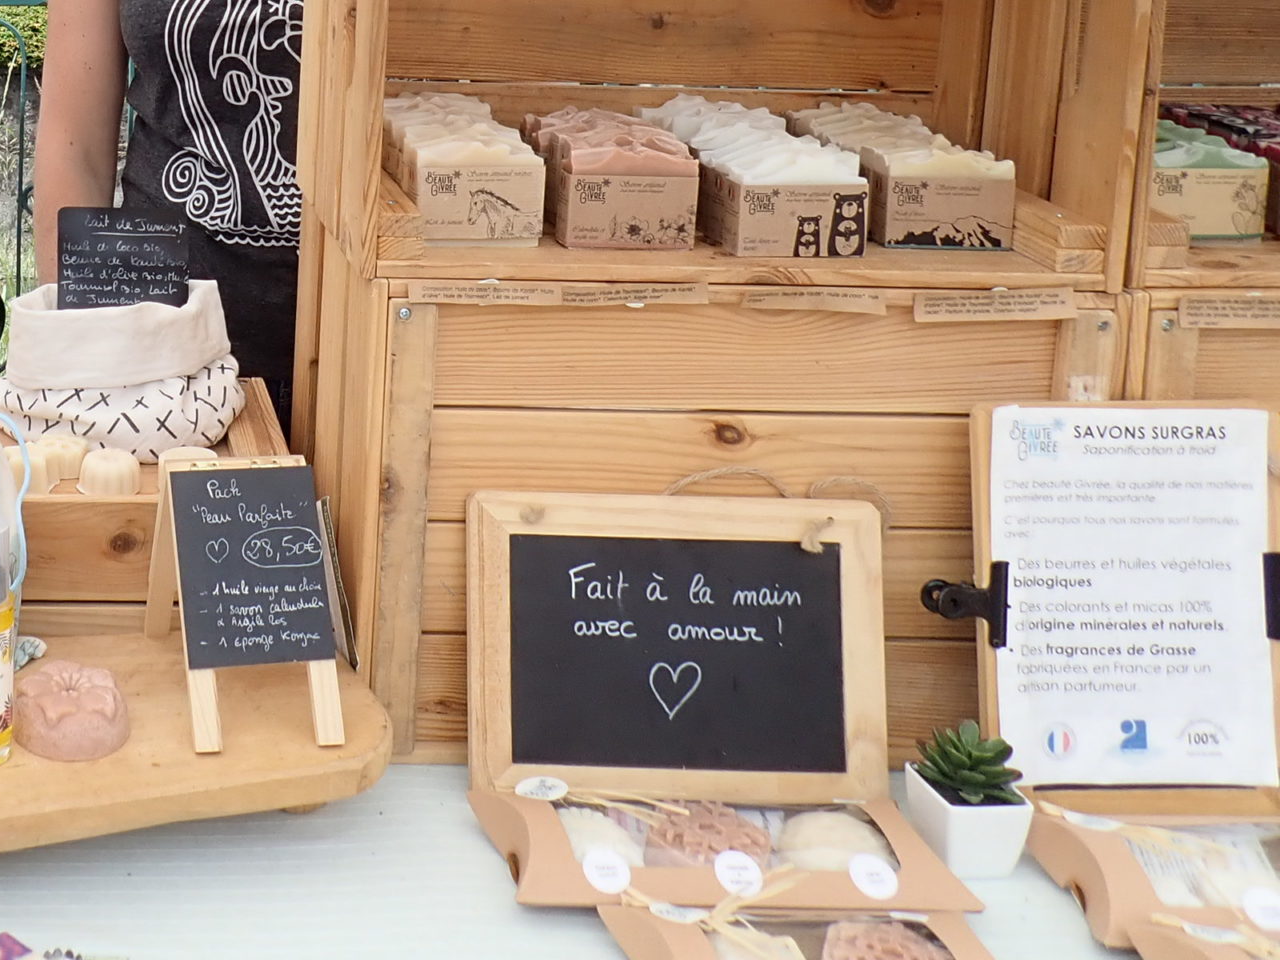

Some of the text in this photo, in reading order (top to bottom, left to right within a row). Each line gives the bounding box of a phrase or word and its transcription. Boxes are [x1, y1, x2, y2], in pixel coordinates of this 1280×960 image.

[116, 218, 133, 230] de
[116, 240, 139, 252] Coco
[108, 255, 122, 266] de
[1073, 425, 1227, 440] SAVONS SURGRAS
[1082, 443, 1216, 457] Saponification à froid
[206, 478, 242, 499] Pack
[1003, 479, 1028, 490] Chez
[1116, 480, 1126, 490] la
[1128, 479, 1165, 492] qualité
[1167, 480, 1181, 491] de
[1185, 482, 1203, 491] nos
[1206, 480, 1254, 492] matières
[1003, 492, 1053, 505] premières
[1056, 493, 1073, 504] est
[1075, 493, 1094, 504] très
[1032, 515, 1081, 528] pourquoi
[1084, 515, 1106, 527] tous
[1108, 518, 1126, 527] nos
[1129, 517, 1166, 527] savons
[1168, 515, 1190, 527] sont
[1191, 515, 1239, 528] formulés
[246, 535, 323, 562] 28,50€
[1017, 557, 1232, 573] Des beurres et huiles végétales
[222, 579, 249, 595] huile
[568, 561, 802, 607] Fait à la main
[1013, 575, 1092, 590] biologiques
[229, 604, 263, 616] savon
[1019, 600, 1213, 613] Des colorants et micas 100%
[573, 617, 639, 640] avec
[667, 621, 765, 643] amour
[1079, 619, 1147, 632] minérales
[1151, 619, 1165, 632] et
[1020, 643, 1197, 659] Des fragrances de Grasse
[1016, 662, 1212, 679] fabriquées en France par un
[1187, 732, 1220, 746] 100%
